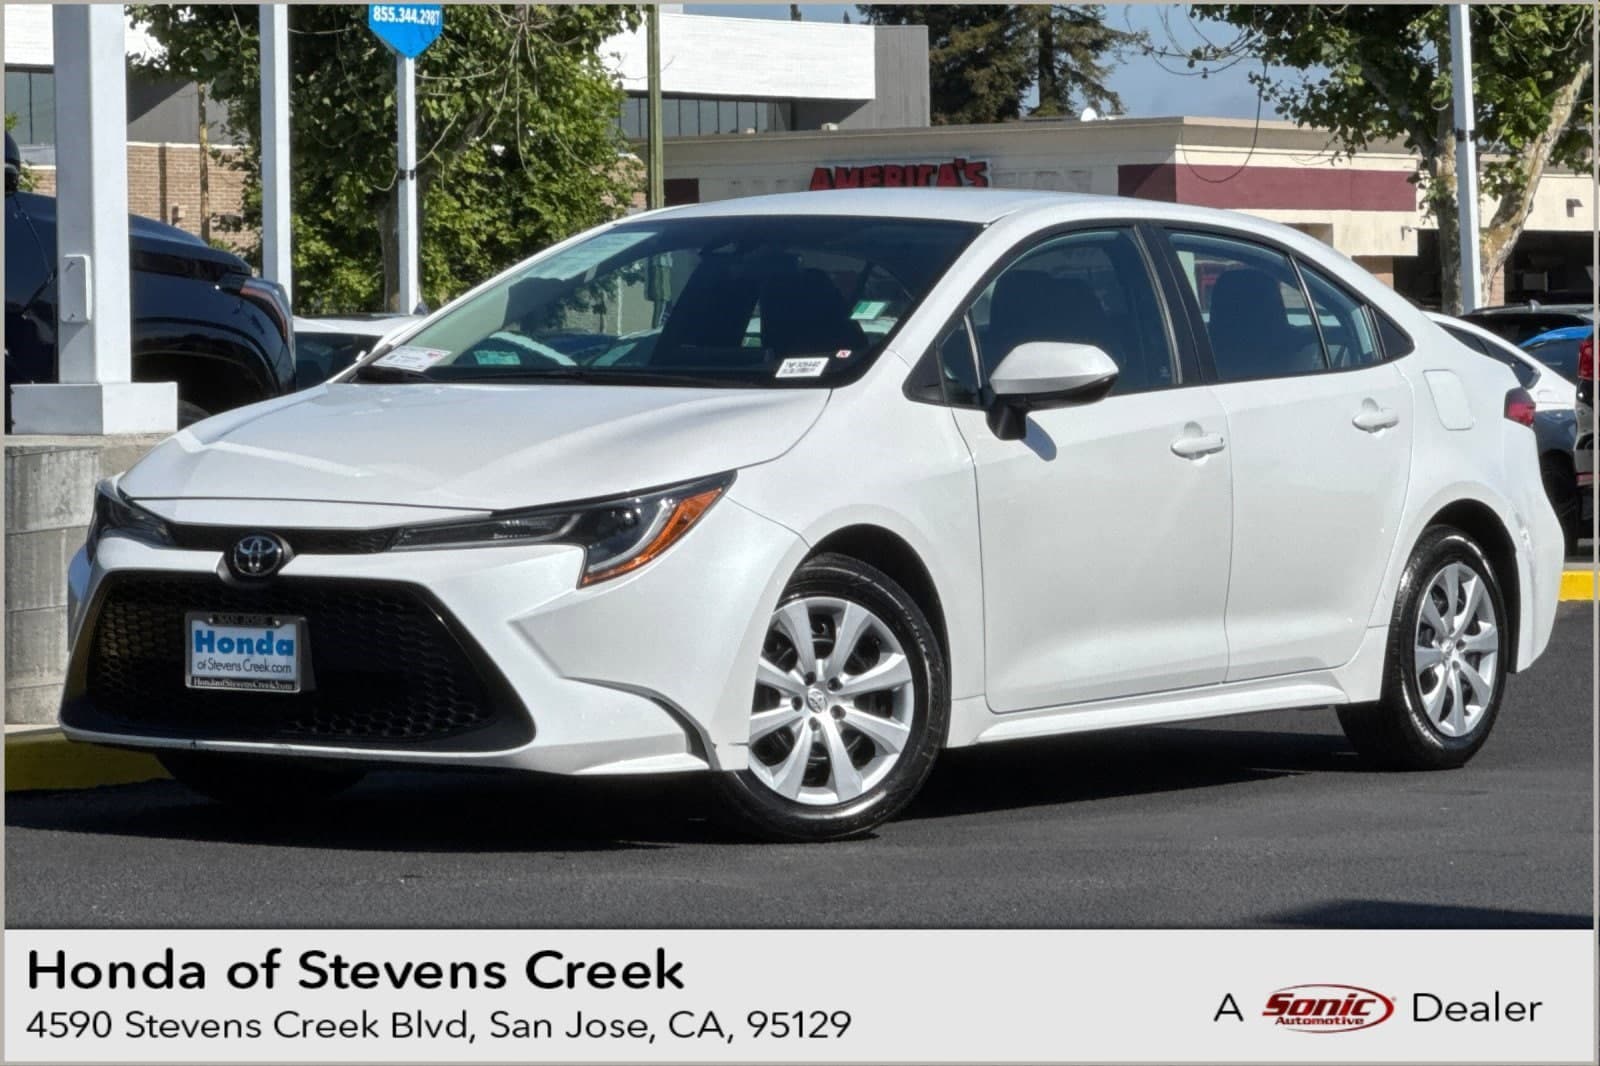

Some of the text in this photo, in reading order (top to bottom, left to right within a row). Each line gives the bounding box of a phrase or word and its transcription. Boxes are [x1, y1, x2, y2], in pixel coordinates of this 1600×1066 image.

[195, 629, 294, 656] Honda
[197, 657, 292, 674] of Stevens Creek.com
